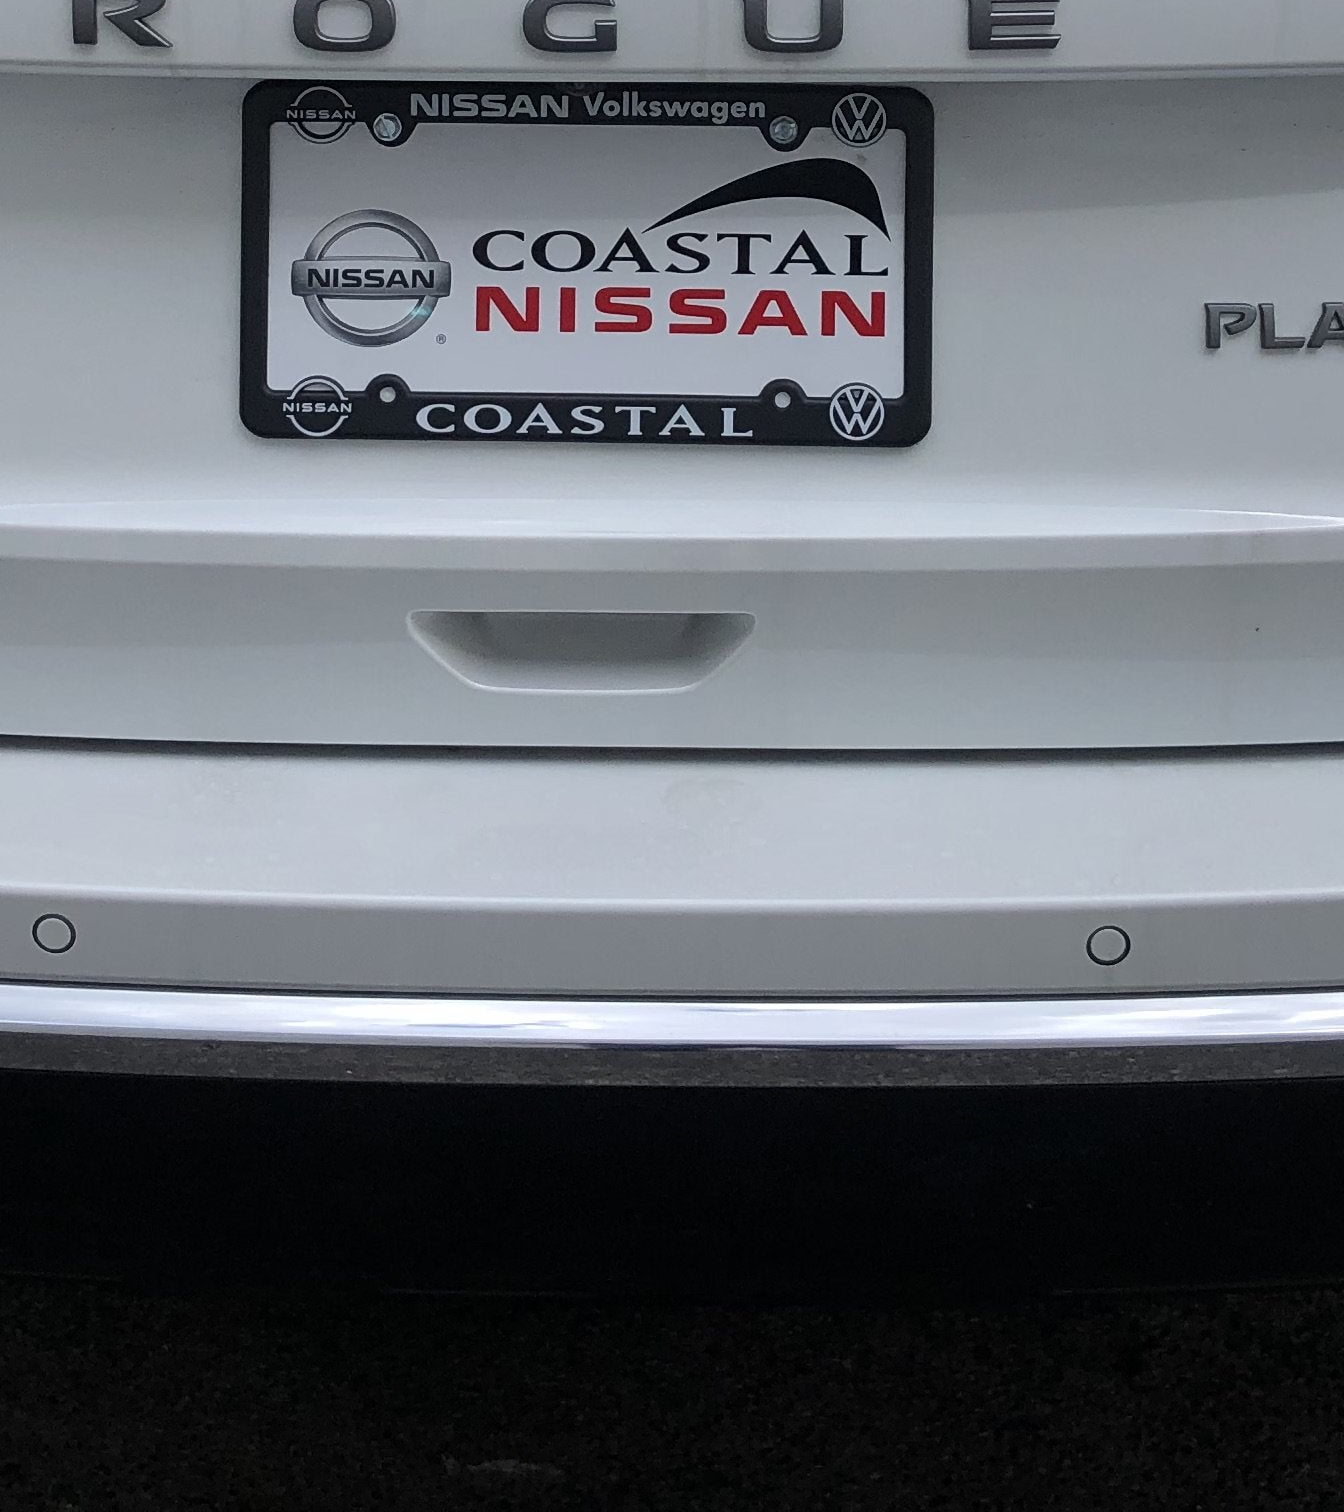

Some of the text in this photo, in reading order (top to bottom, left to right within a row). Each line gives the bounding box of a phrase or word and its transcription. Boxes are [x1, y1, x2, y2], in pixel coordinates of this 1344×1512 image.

[286, 109, 356, 120] NISSAN
[410, 91, 766, 121] NISSAN Volkswagen
[472, 227, 889, 277] COASTAL
[307, 268, 435, 289] NISSAN
[474, 286, 887, 338] NISSAN
[282, 402, 353, 414] NISSAN
[415, 402, 754, 438] COASTAL
